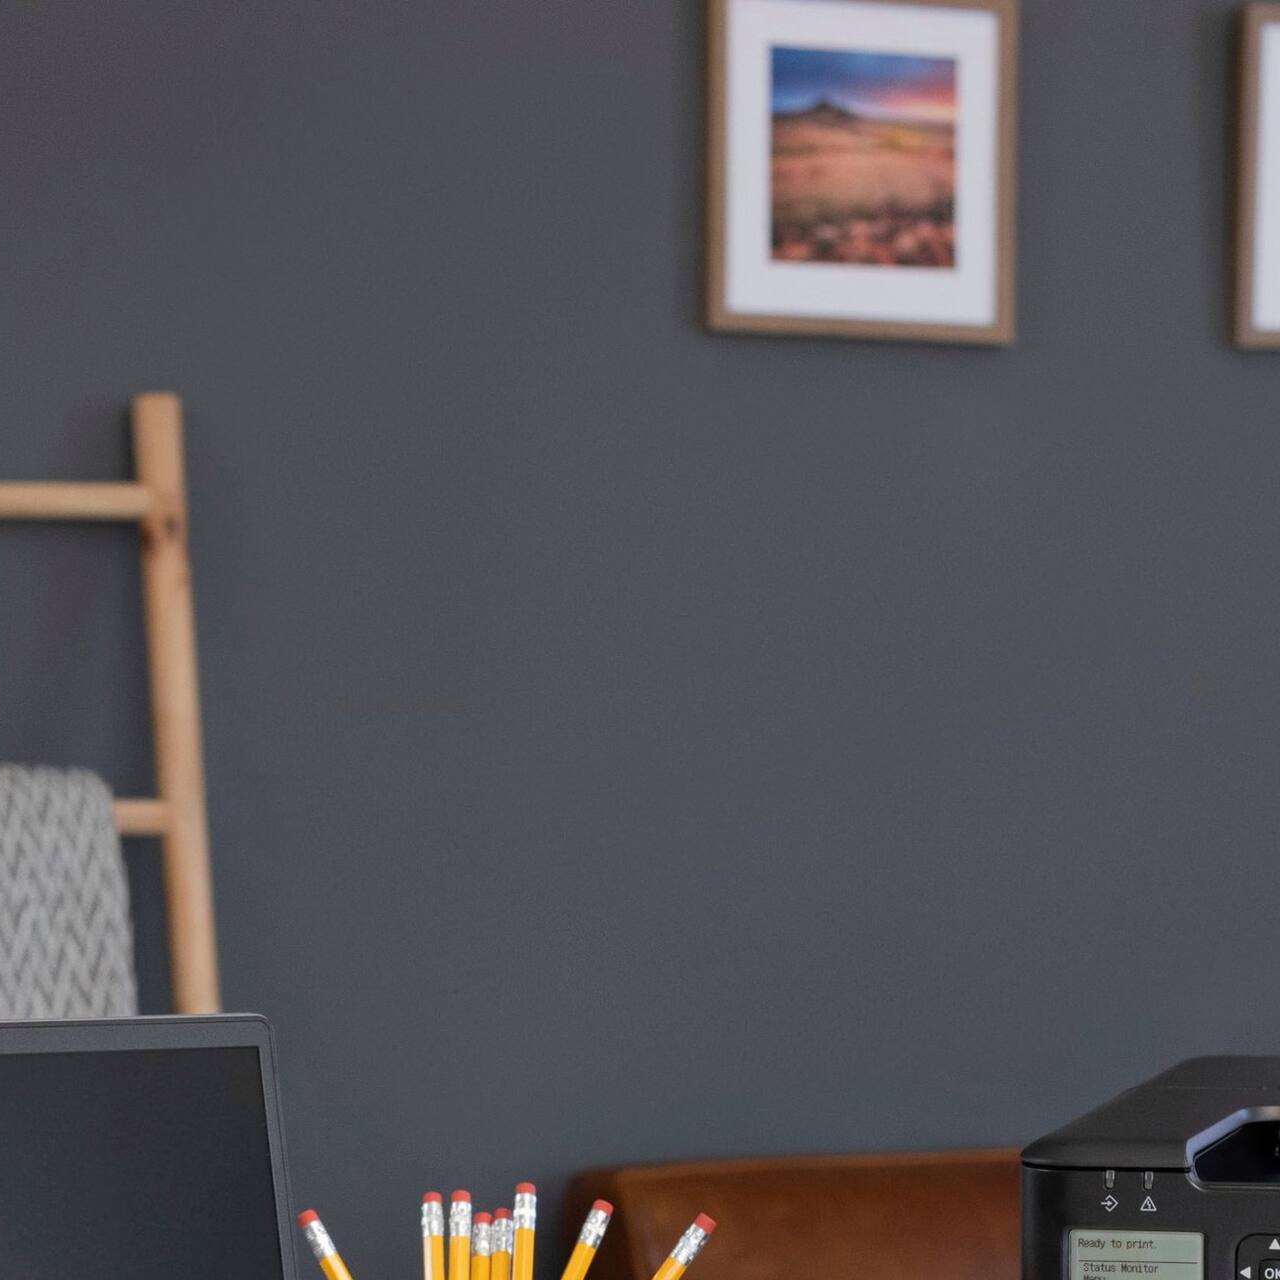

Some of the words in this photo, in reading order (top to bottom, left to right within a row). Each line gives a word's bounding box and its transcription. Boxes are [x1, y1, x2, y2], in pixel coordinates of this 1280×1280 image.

[1078, 1239, 1105, 1250] Ready
[1111, 1239, 1122, 1249] to
[1083, 1262, 1116, 1273] Status
[1121, 1263, 1158, 1274] Monitor
